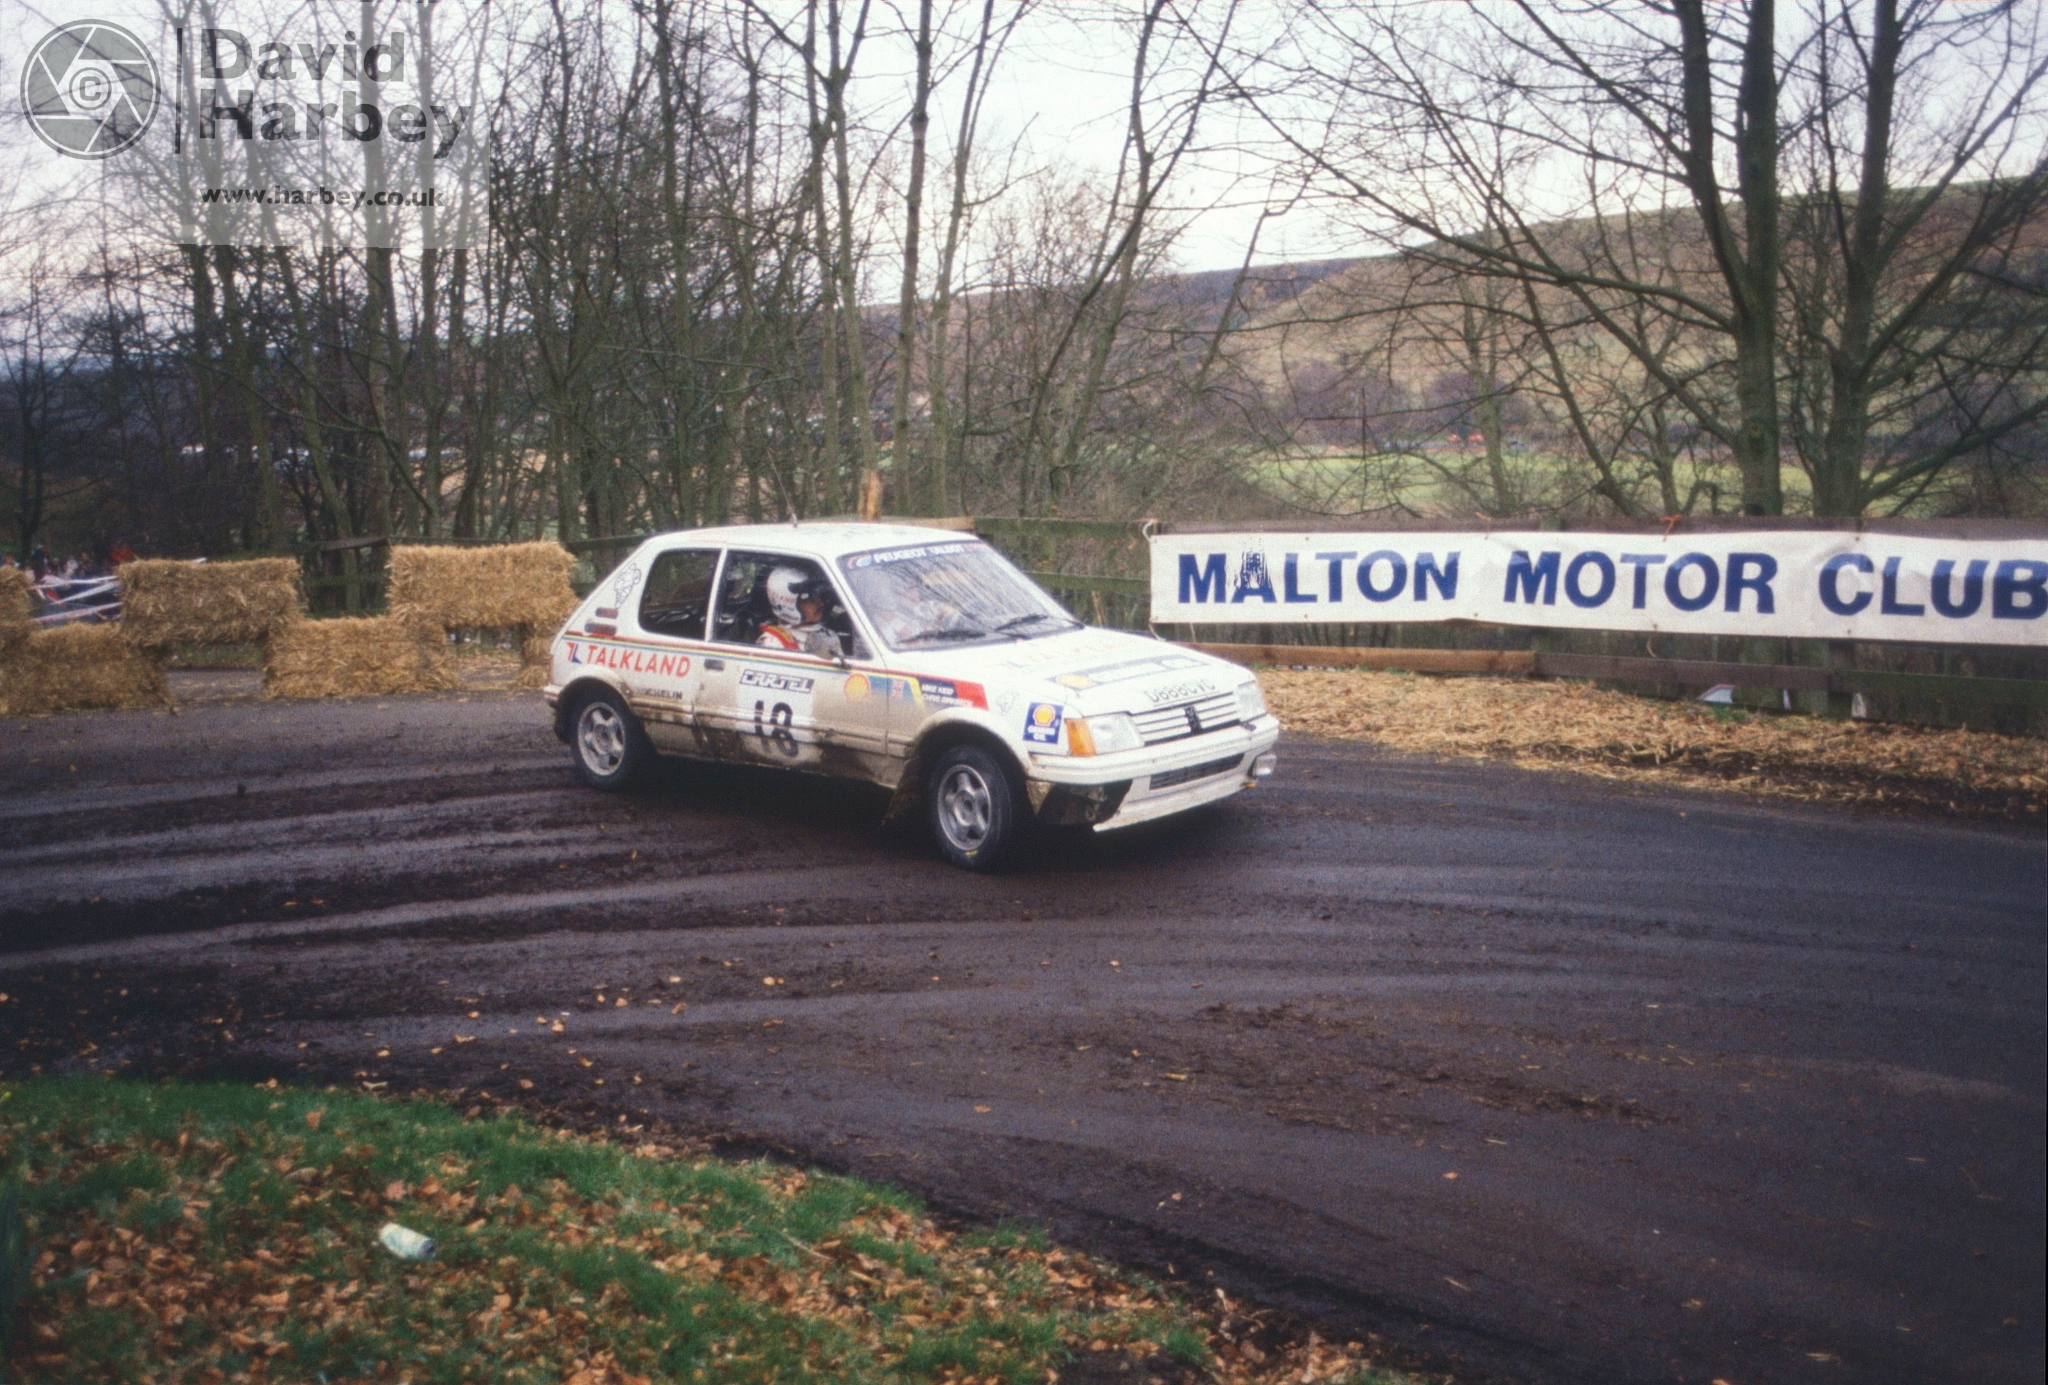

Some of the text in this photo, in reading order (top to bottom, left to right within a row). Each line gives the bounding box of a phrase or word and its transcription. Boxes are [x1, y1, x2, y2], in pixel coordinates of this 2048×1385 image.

[1178, 549, 2048, 620] MALTON MOTOR CLUB
[588, 644, 691, 678] TALKLAND
[742, 669, 811, 693] CARTEL
